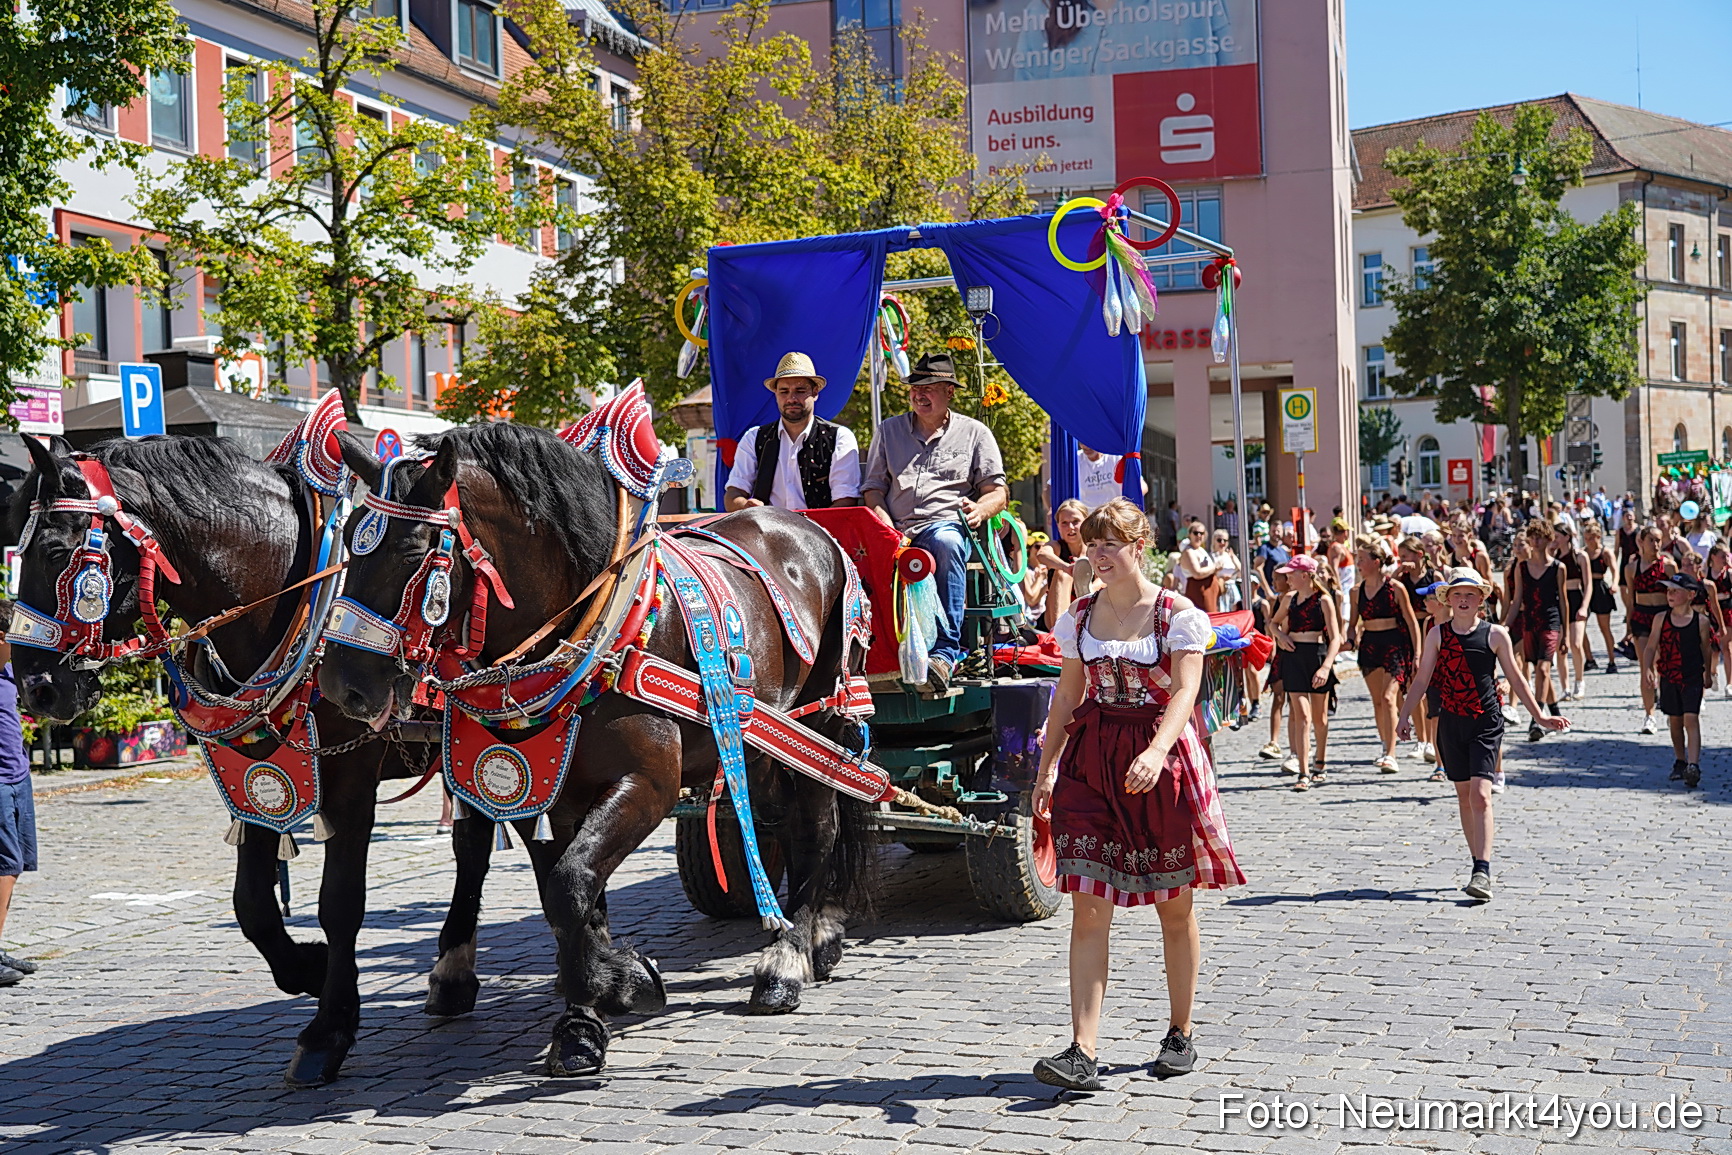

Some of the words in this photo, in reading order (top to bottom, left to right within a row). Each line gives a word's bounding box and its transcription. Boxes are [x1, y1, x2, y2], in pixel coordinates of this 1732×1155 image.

[985, 11, 1049, 35] Mehr
[1056, 0, 1224, 30] Überholspur.
[985, 45, 1093, 72] Weniger
[1100, 34, 1243, 63] Sackgasse.
[988, 104, 1094, 125] Ausbildung
[988, 133, 1016, 152] bei
[1022, 135, 1061, 150] uns.
[1060, 159, 1094, 174] jetzt!
[129, 374, 153, 429] P
[1292, 399, 1304, 415] H
